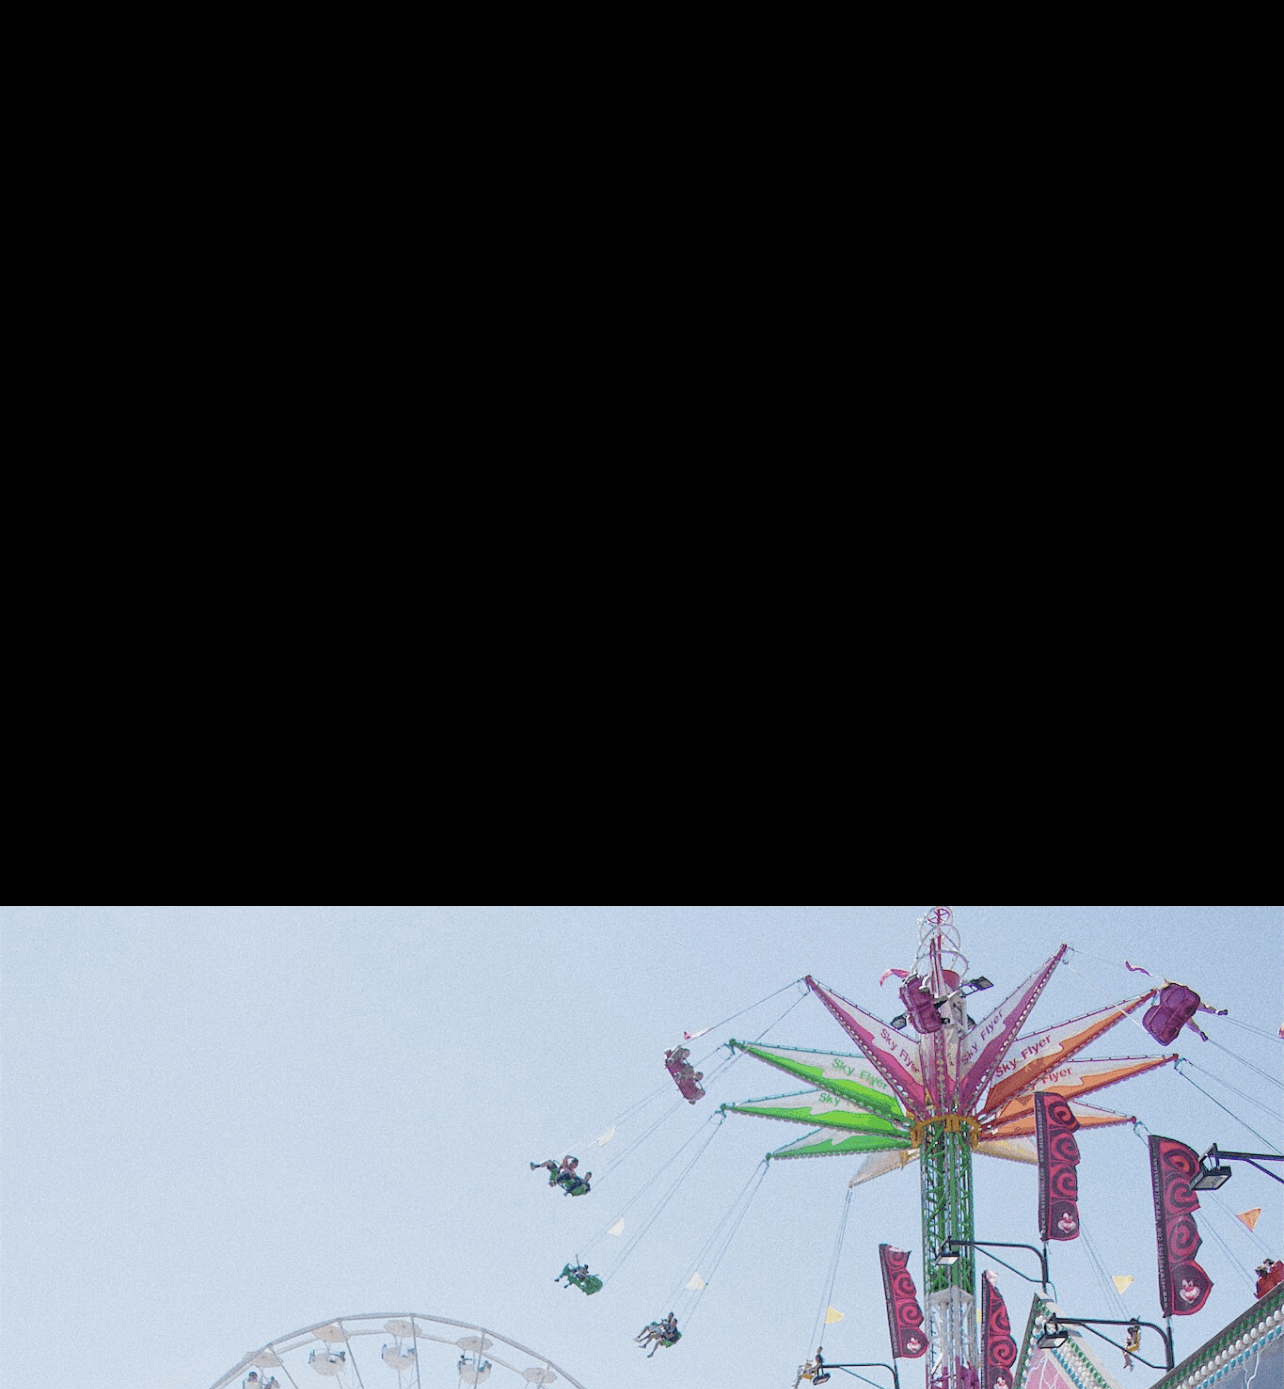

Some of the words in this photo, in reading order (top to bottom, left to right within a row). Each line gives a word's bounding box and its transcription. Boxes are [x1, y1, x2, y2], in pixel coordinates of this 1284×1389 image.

[881, 1028, 897, 1051] Sky
[961, 1042, 979, 1065] Sky
[980, 1010, 1003, 1041] Flyer
[995, 1058, 1017, 1078] Sky
[1020, 1034, 1052, 1060] Flyer
[832, 1057, 855, 1076] Sky
[859, 1070, 888, 1089] Flyer
[1041, 1066, 1073, 1085] Flyer
[818, 1092, 841, 1106] Sky
